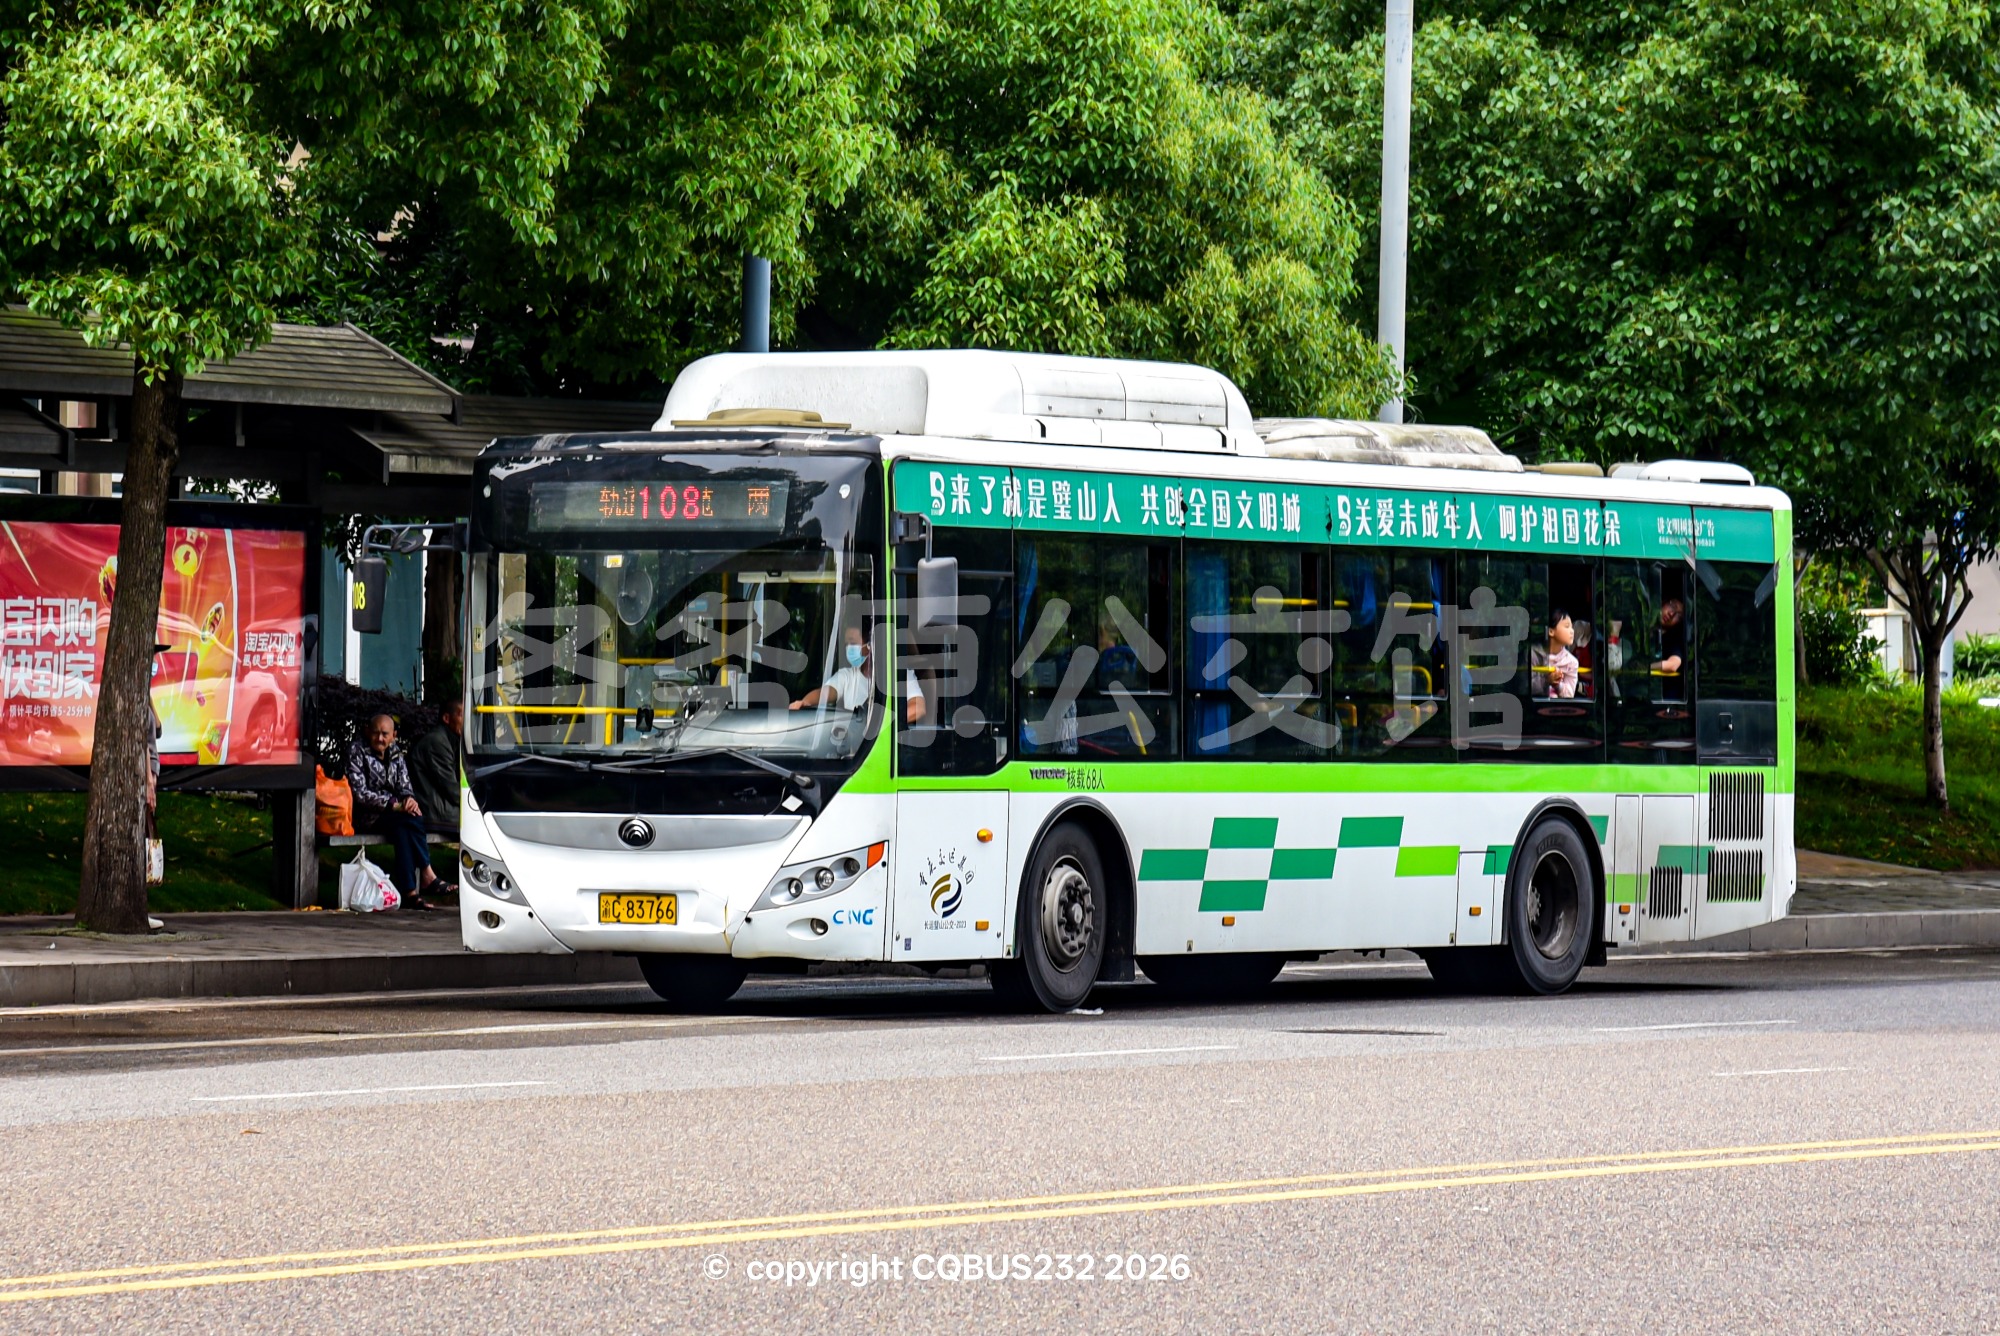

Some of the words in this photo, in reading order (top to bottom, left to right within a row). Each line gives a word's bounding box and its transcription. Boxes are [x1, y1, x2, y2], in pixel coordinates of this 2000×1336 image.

[639, 485, 700, 519] 108
[950, 473, 1121, 524] 来了就是璧山人
[1140, 483, 1301, 533] 共创全国文明城
[1356, 496, 1483, 541] 关爱未成年人
[1500, 504, 1622, 547] 呵护祖国花朵
[0, 596, 97, 646] 宝闪购
[244, 632, 296, 652] 淘宝闪购
[0, 650, 95, 700] 快到家
[833, 909, 874, 925] CNG
